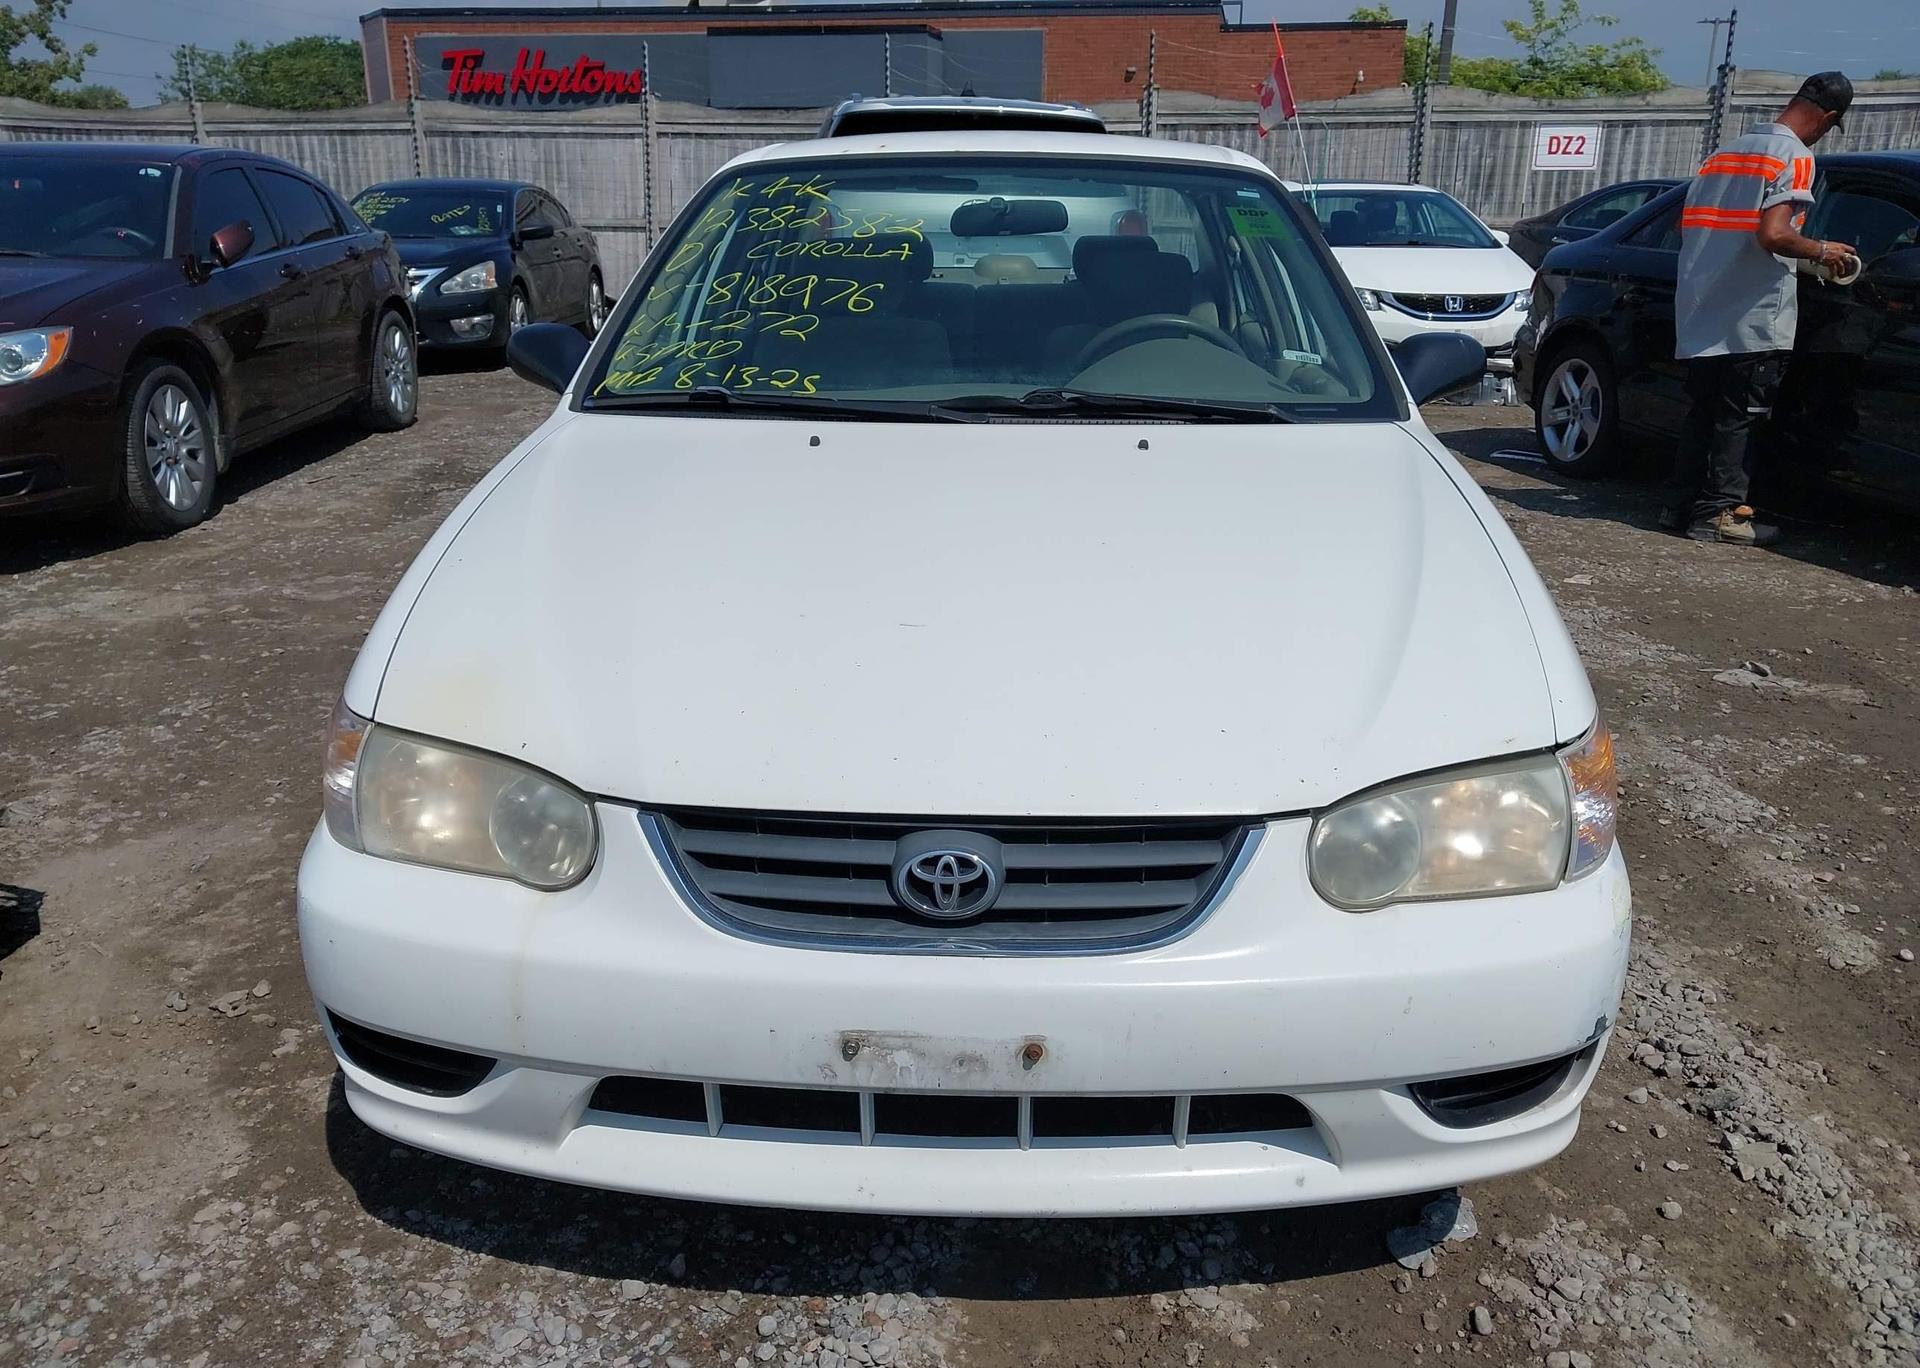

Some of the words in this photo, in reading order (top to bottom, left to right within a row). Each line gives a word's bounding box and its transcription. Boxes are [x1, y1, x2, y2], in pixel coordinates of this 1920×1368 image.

[441, 50, 504, 94] Tim
[508, 48, 642, 94] Hortons
[1547, 135, 1587, 155] DZ2
[746, 239, 914, 262] COROLLA
